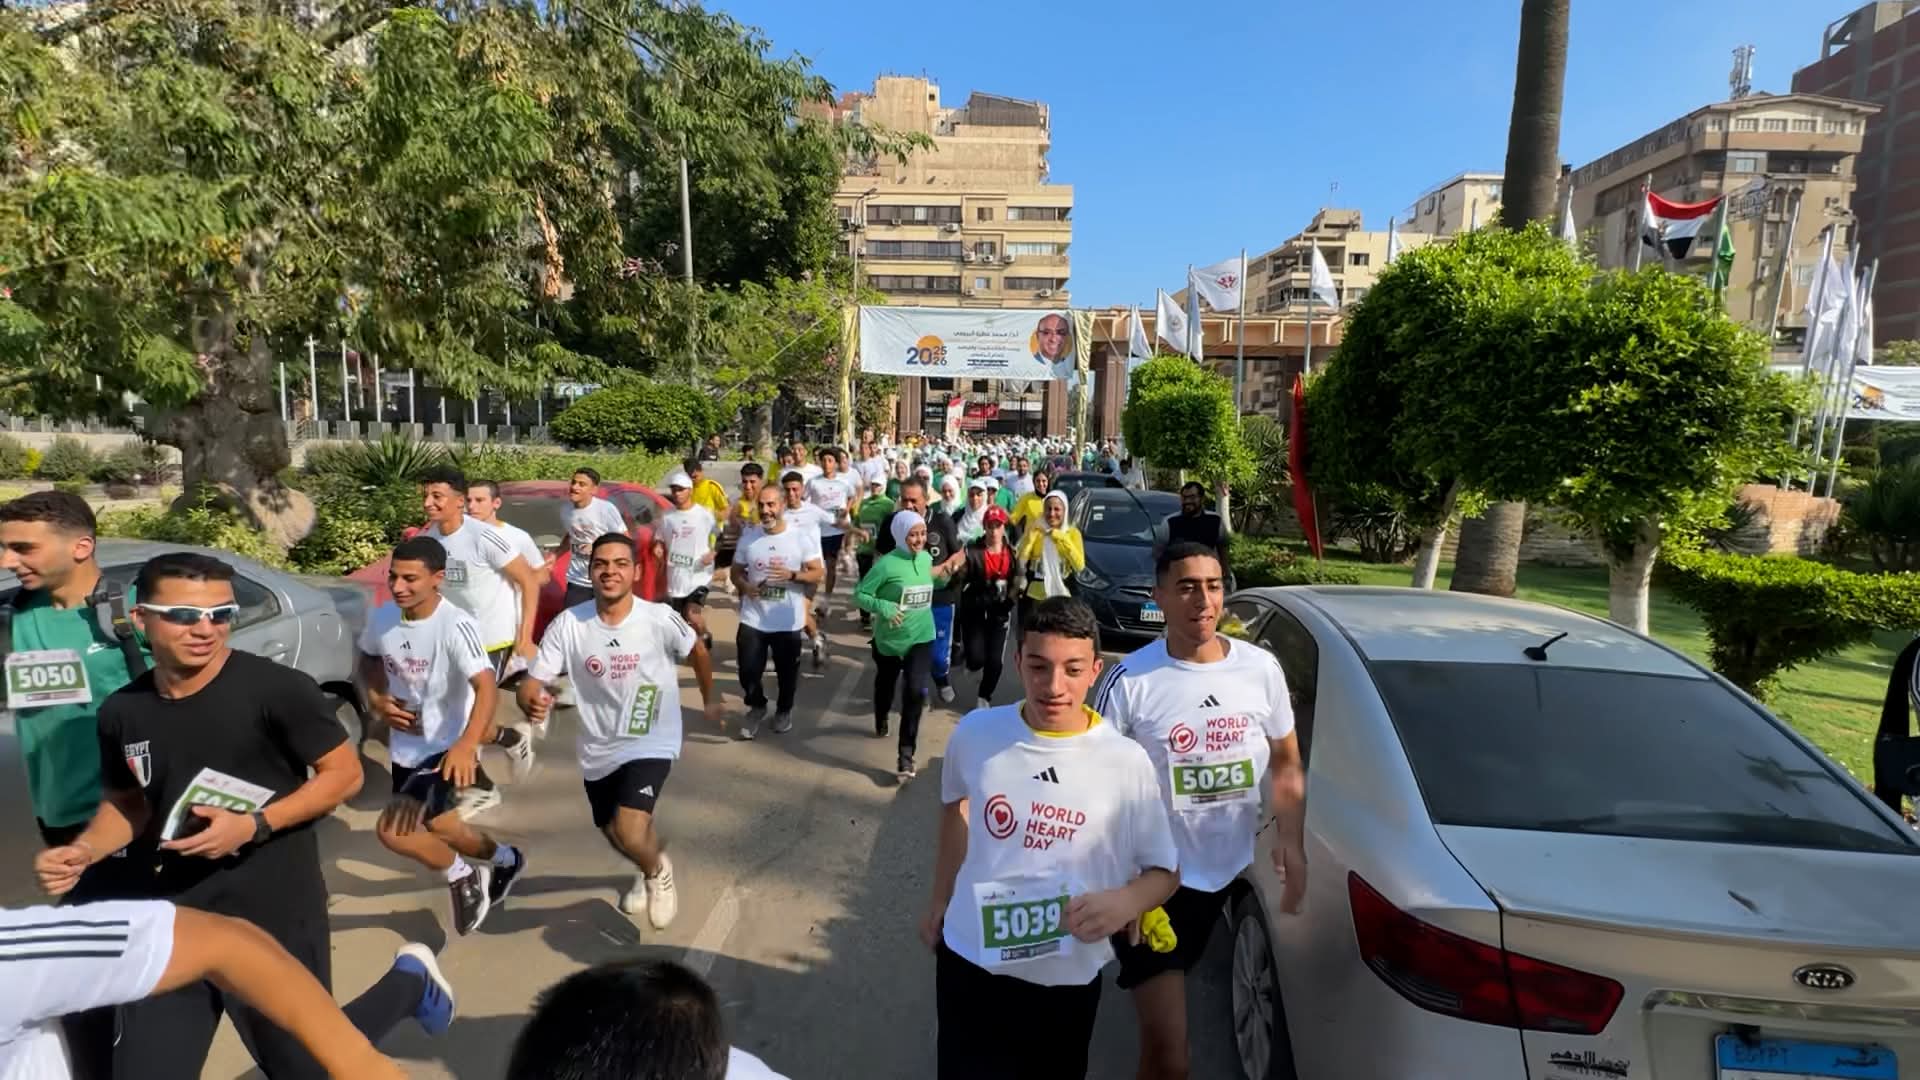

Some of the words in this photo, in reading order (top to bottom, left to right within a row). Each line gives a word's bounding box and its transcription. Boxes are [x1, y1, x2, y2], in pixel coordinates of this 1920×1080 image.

[906, 347, 932, 365] 20
[932, 346, 947, 356] 25
[932, 357, 947, 366] 26
[610, 653, 640, 662] WORLD
[610, 662, 638, 671] HEART
[17, 664, 77, 689] 5050
[1206, 717, 1249, 729] WORLD
[1205, 730, 1245, 744] HEART
[125, 740, 150, 758] EGYPT
[1205, 743, 1231, 753] DAY
[1182, 764, 1247, 791] 5026
[1031, 801, 1087, 826] WORLD
[1026, 818, 1077, 842] HEART
[1023, 834, 1054, 851] DAY
[993, 901, 1061, 941] 5039
[1805, 970, 1845, 988] KIA
